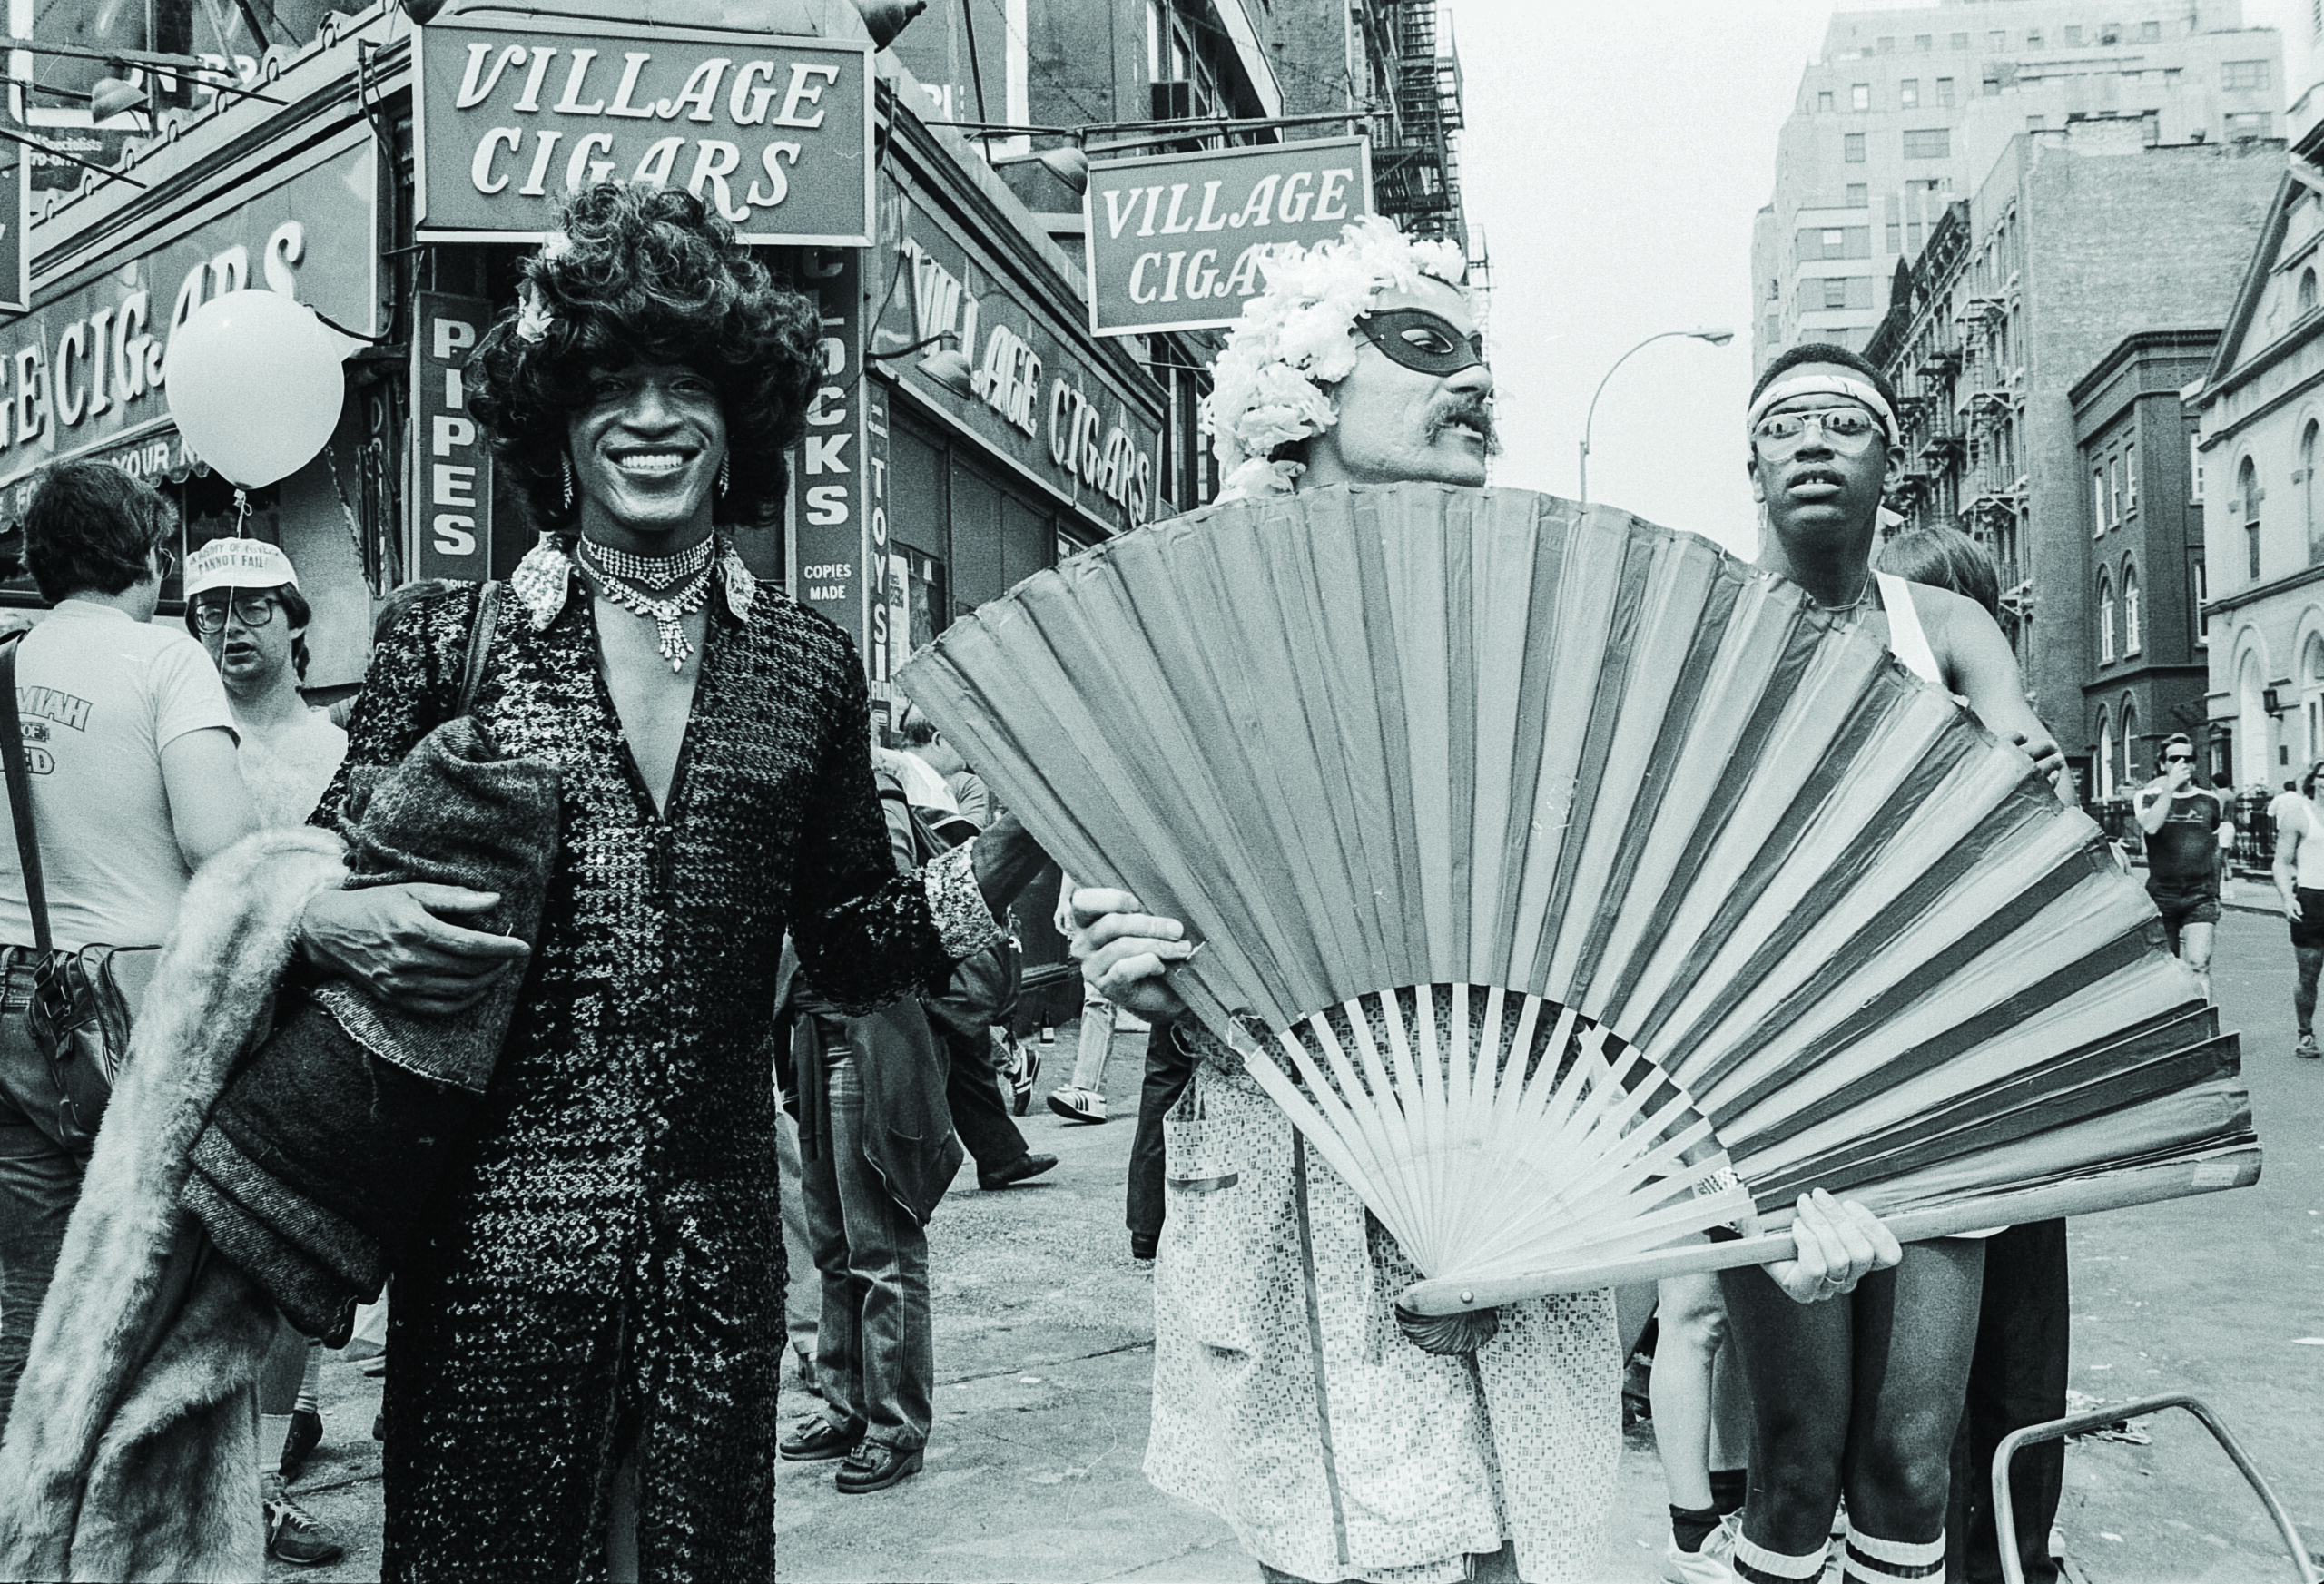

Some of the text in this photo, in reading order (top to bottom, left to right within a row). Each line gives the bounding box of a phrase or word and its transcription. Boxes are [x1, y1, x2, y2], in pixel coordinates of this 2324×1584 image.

[456, 42, 840, 129] VILLAGE
[470, 126, 801, 222] CIGARS
[1102, 168, 1354, 239] VILLAGE
[1128, 239, 1341, 304] CIGA
[897, 236, 1150, 528] VILLAGE CIGARS
[433, 318, 476, 556] PIPES
[198, 554, 263, 576] CANNOT FAIL
[803, 564, 852, 579] COPIES
[810, 585, 846, 600] MADE
